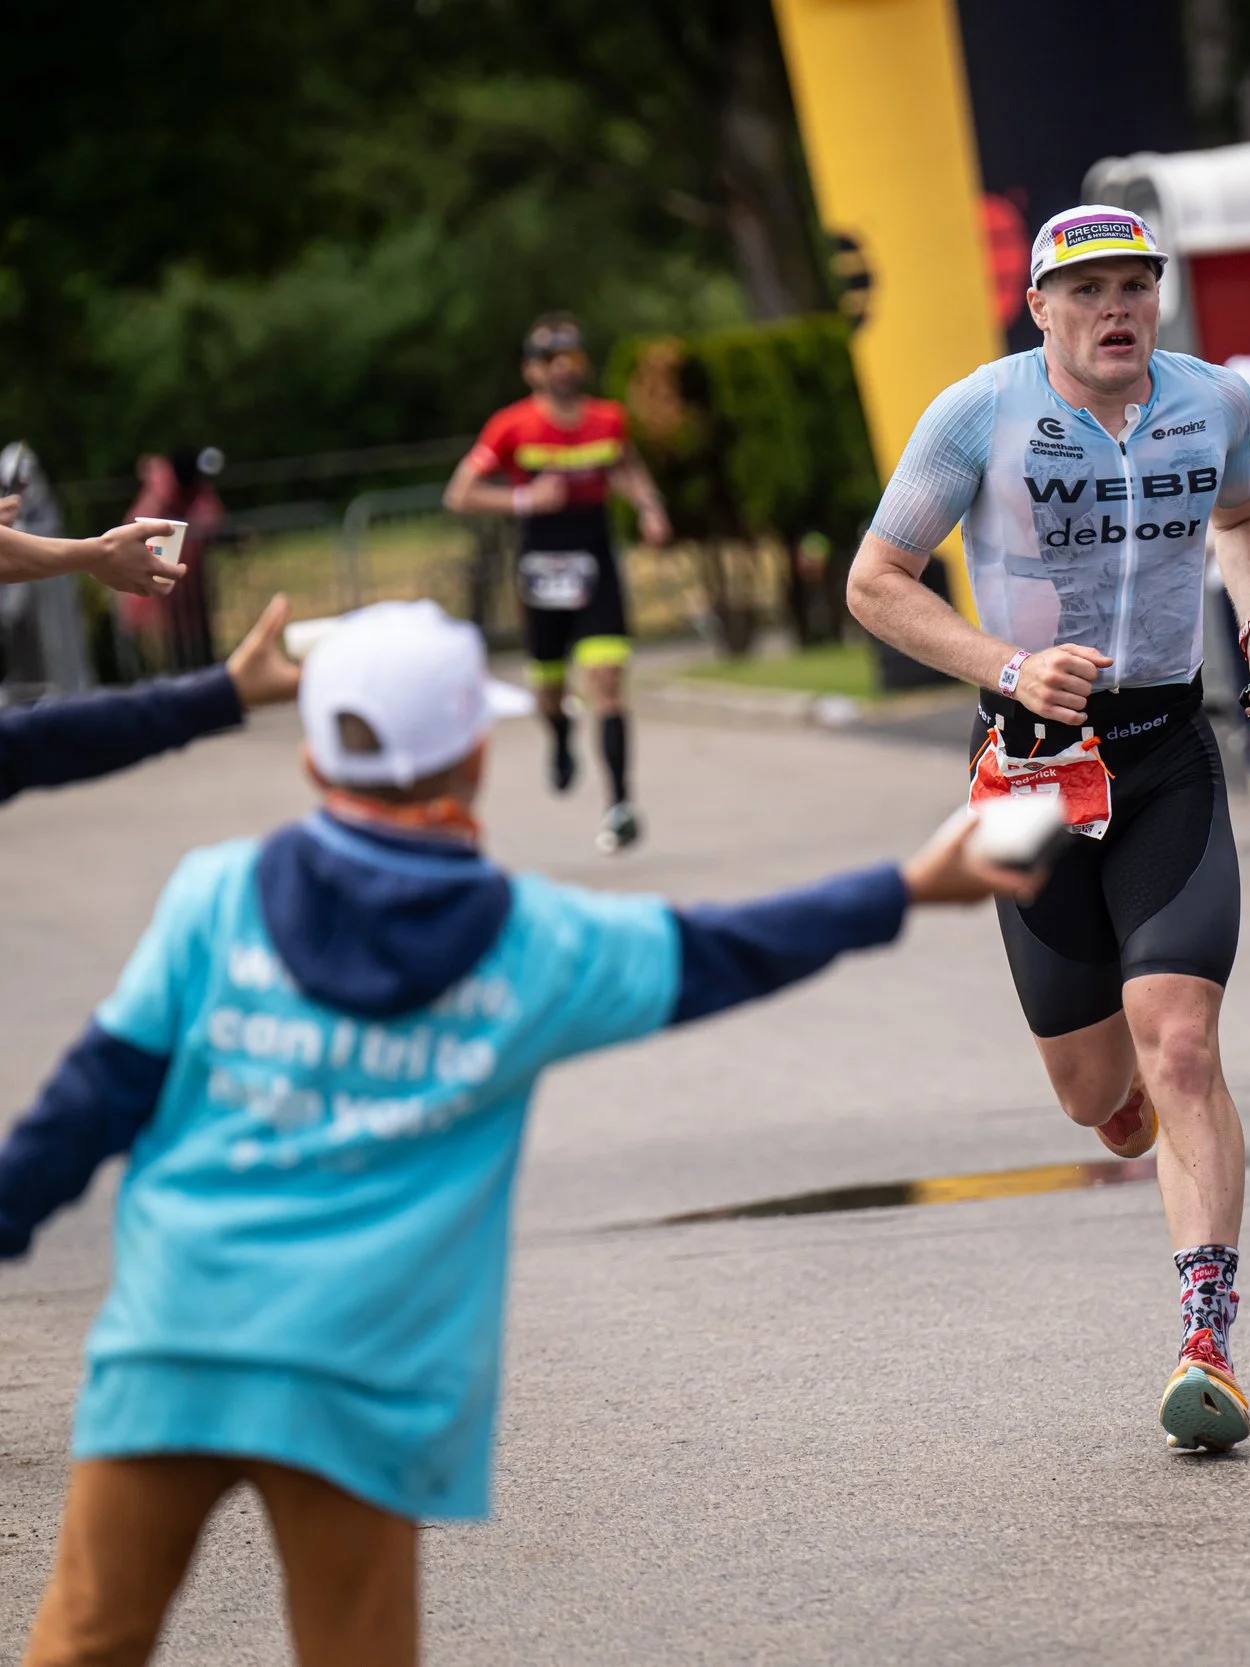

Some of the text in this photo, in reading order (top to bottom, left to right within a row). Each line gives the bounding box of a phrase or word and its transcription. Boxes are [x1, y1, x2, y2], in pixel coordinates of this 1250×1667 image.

[1067, 224, 1130, 240] PRECISION
[1068, 236, 1087, 246] FUEL
[1166, 419, 1207, 437] nopinz
[1029, 439, 1084, 453] Cheetham
[1032, 447, 1084, 460] Coaching
[1023, 466, 1218, 503] WEBB
[1046, 515, 1201, 547] deboer
[1106, 713, 1169, 741] deboer
[207, 1005, 322, 1069] can
